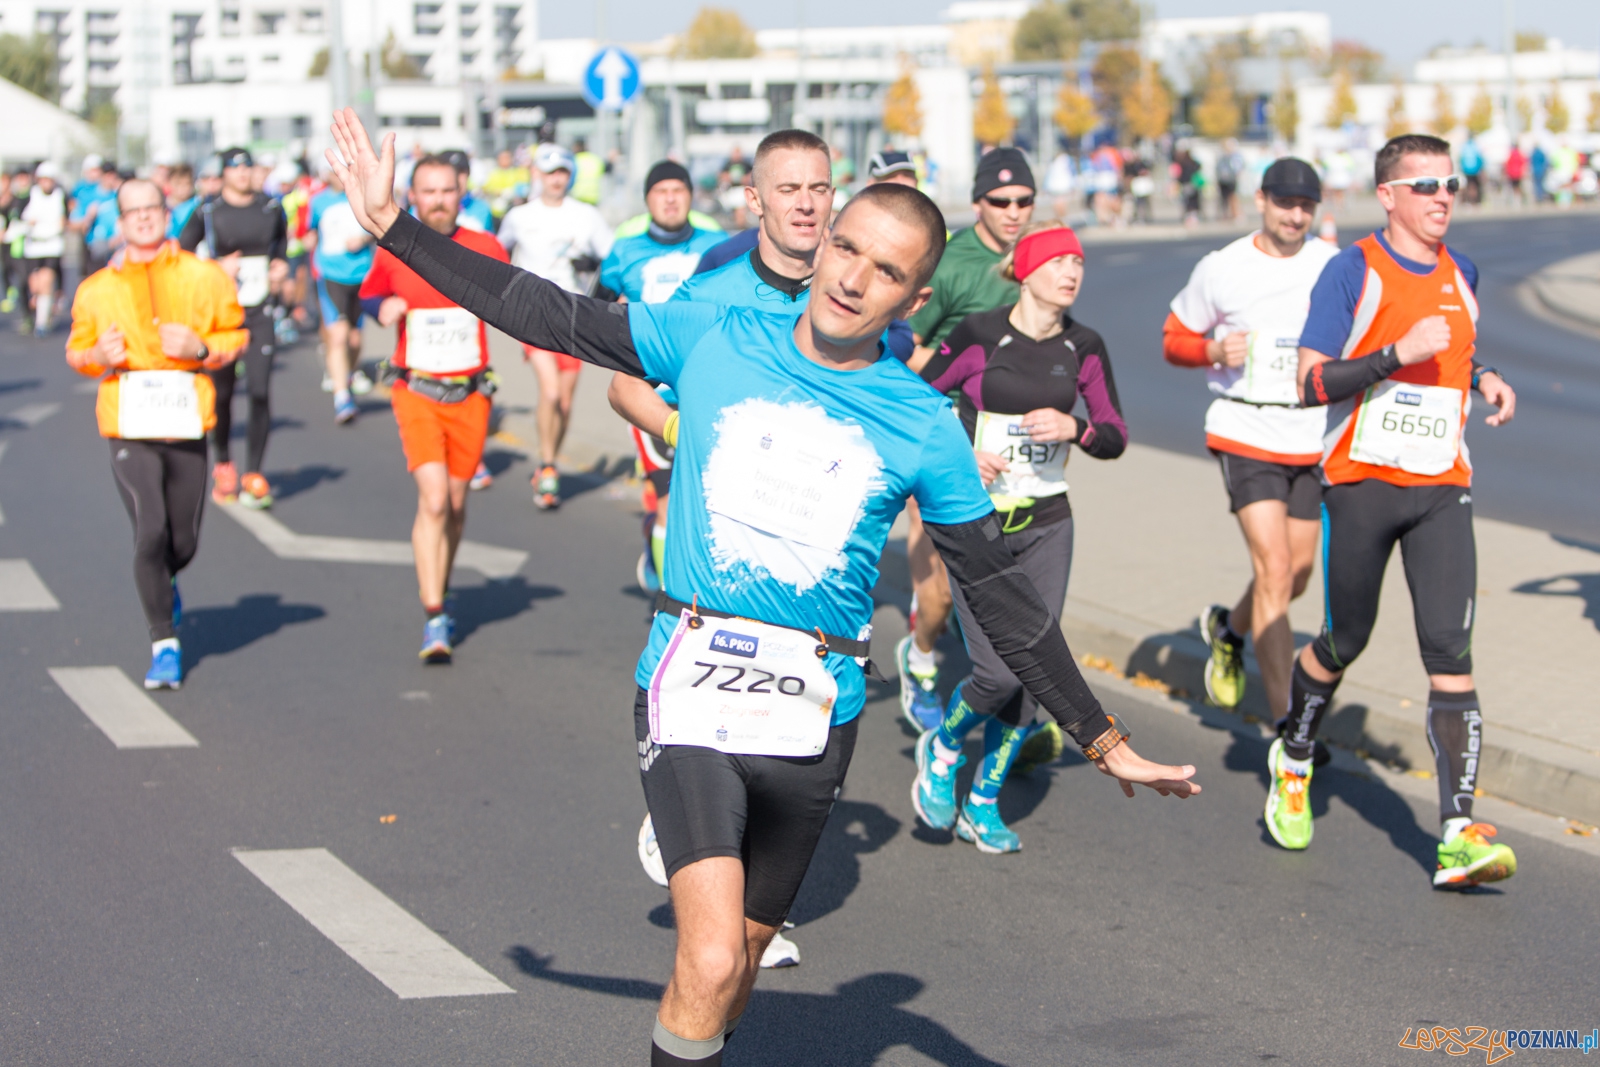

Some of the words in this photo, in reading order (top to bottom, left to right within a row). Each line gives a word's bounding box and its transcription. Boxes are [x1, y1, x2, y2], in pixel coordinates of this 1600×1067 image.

[1381, 410, 1447, 439] 6650
[999, 443, 1061, 464] 4937
[801, 486, 822, 502] dla
[691, 661, 805, 696] 7220
[719, 704, 770, 718] Zbigniew
[1293, 692, 1325, 743] Kalenji
[989, 726, 1020, 781] Kalenji
[1459, 710, 1482, 792] Kalenji
